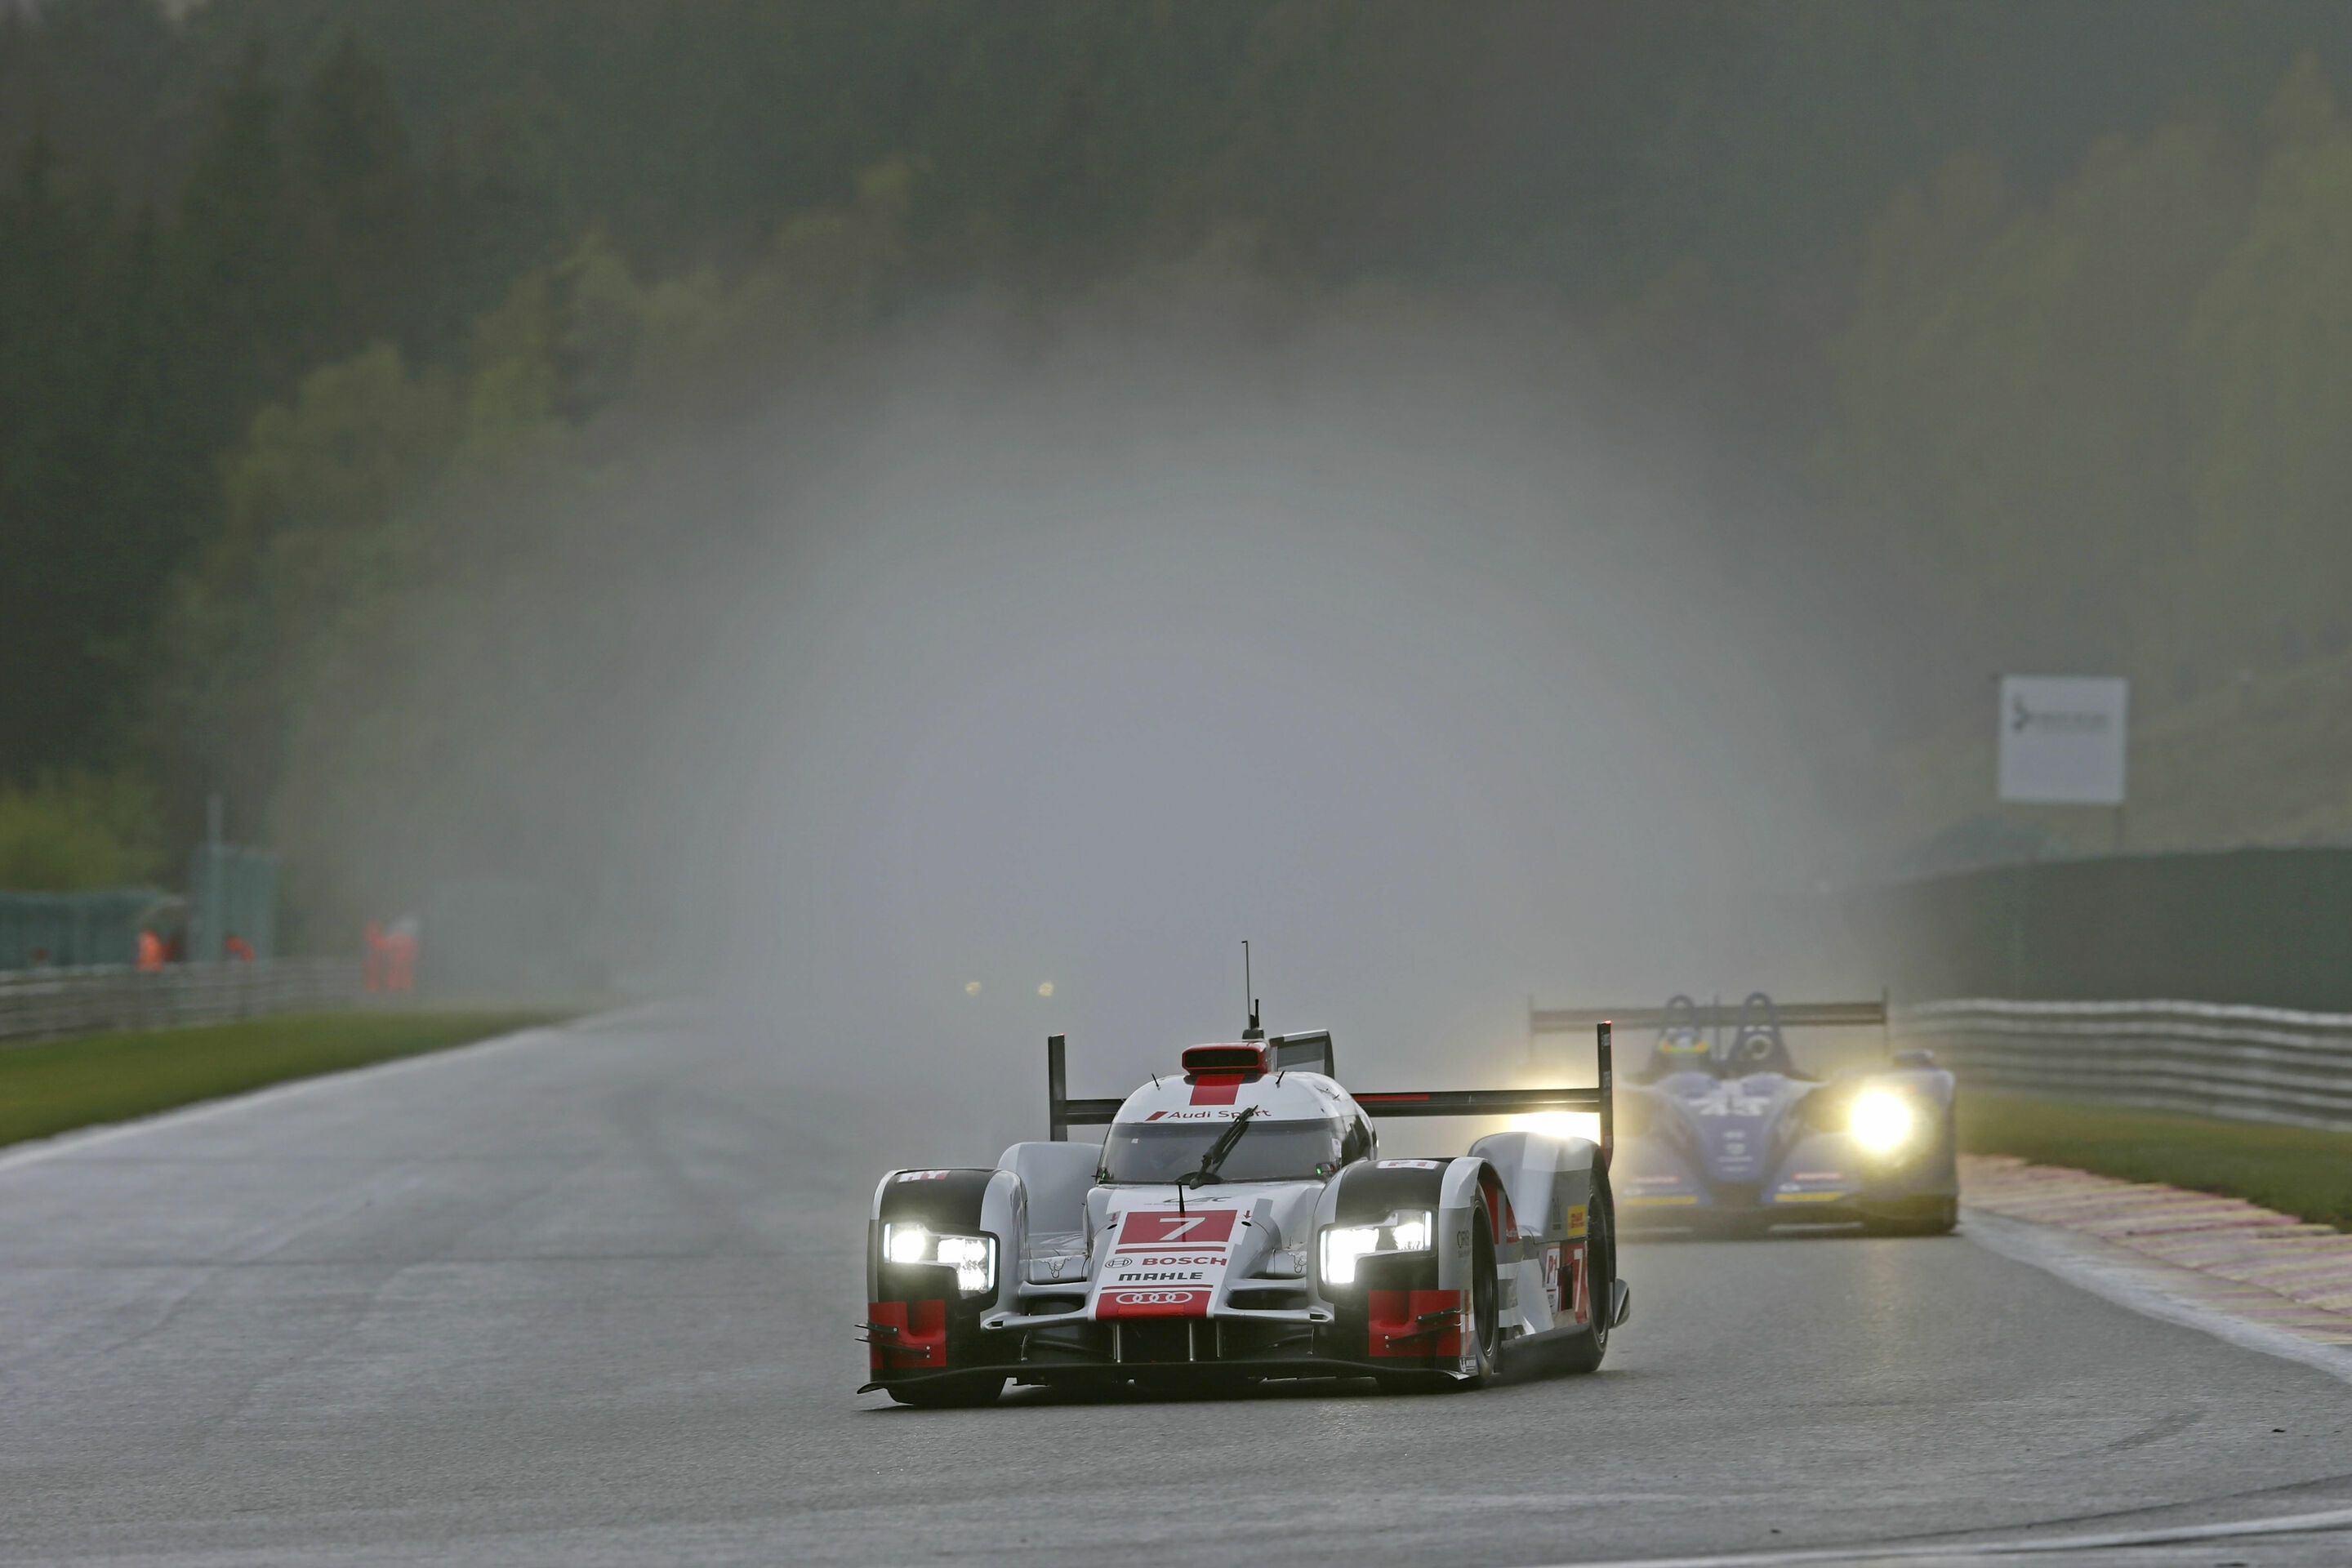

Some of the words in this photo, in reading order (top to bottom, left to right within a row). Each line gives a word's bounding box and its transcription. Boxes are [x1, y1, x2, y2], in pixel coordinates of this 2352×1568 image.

[1168, 1111, 1210, 1119] Audi
[1159, 1217, 1206, 1241] 7
[1142, 1256, 1227, 1267] BOSCH
[1118, 1272, 1204, 1281] MAHLE
[1573, 1248, 1584, 1312] 7
